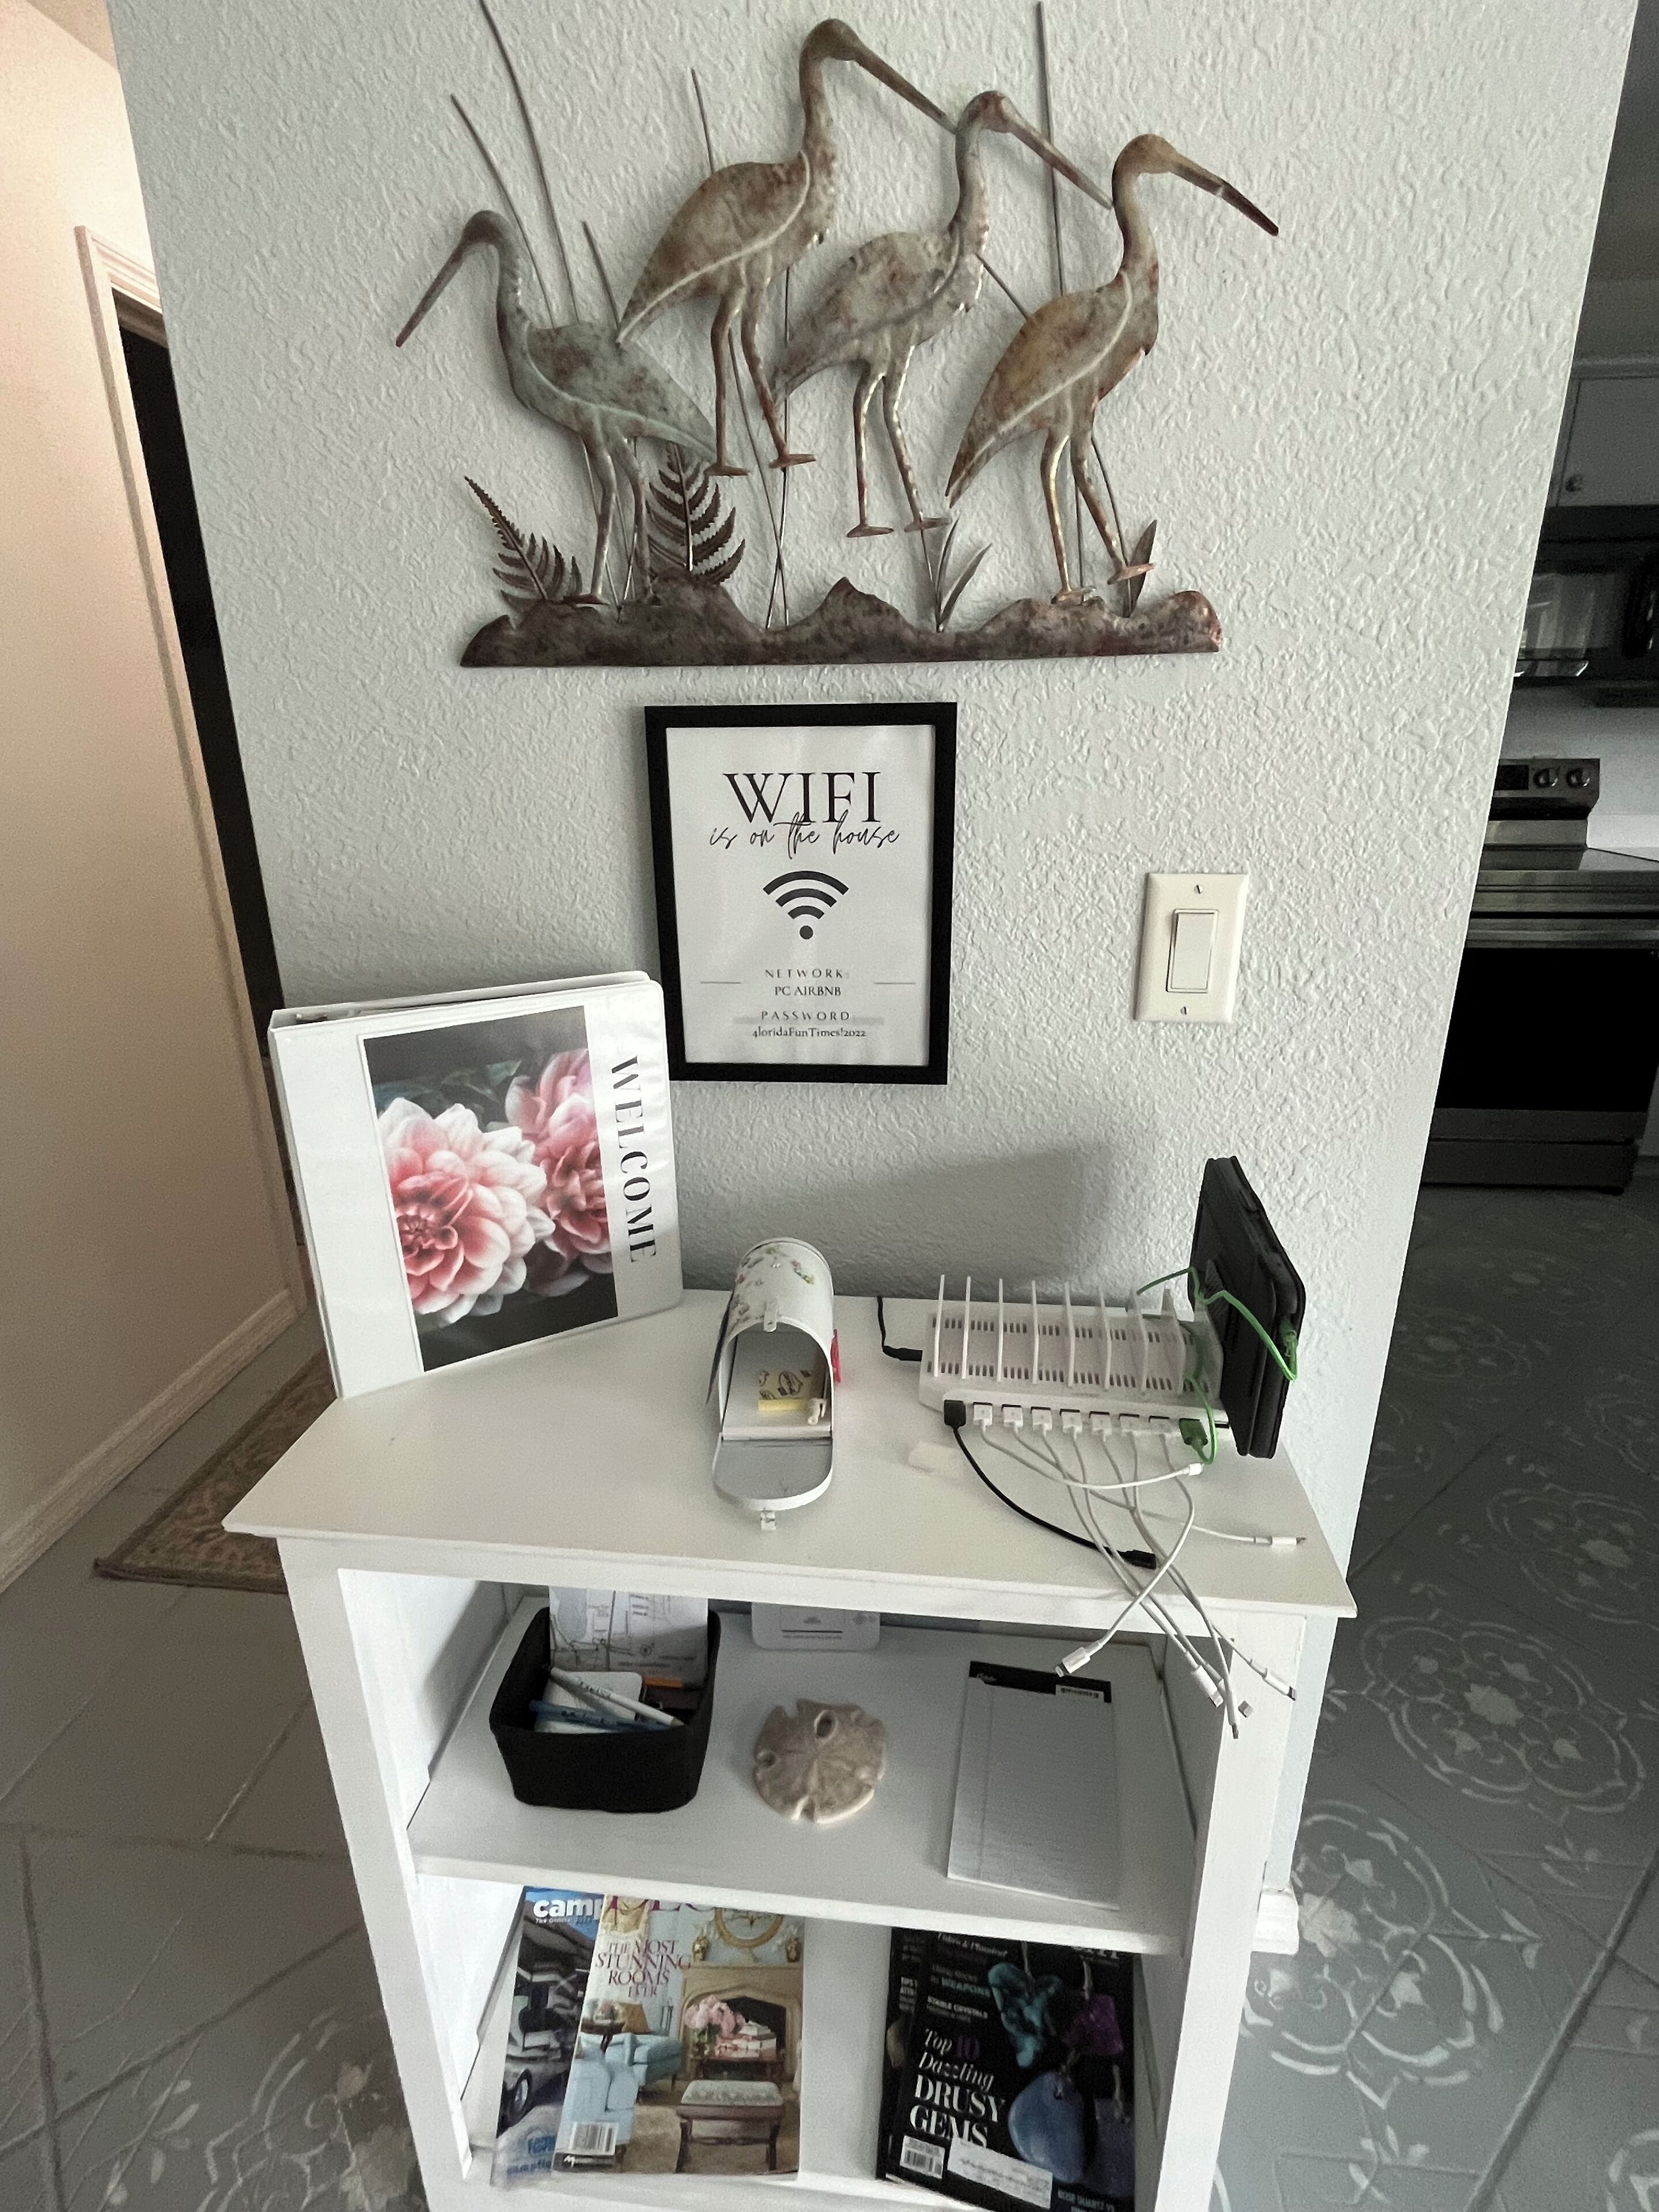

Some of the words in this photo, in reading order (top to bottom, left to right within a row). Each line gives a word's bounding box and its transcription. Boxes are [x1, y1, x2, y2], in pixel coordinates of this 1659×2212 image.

[722, 771, 881, 823] WIFI
[709, 827, 738, 850] is
[749, 830, 775, 847] on
[772, 811, 820, 859] the
[832, 809, 900, 855] house
[774, 986, 792, 996] PC
[794, 986, 842, 996] AIRBNB
[611, 1055, 657, 1263] WELCOME
[594, 1952, 692, 1970] STUNNING
[634, 1939, 680, 1955] MOST
[608, 1969, 670, 1986] ROOMS
[925, 2028, 953, 2055] Top
[956, 2035, 980, 2061] 10
[918, 2051, 994, 2092] Dazzling
[915, 2074, 1006, 2122] DRUSY
[910, 2104, 988, 2148] GEMS
